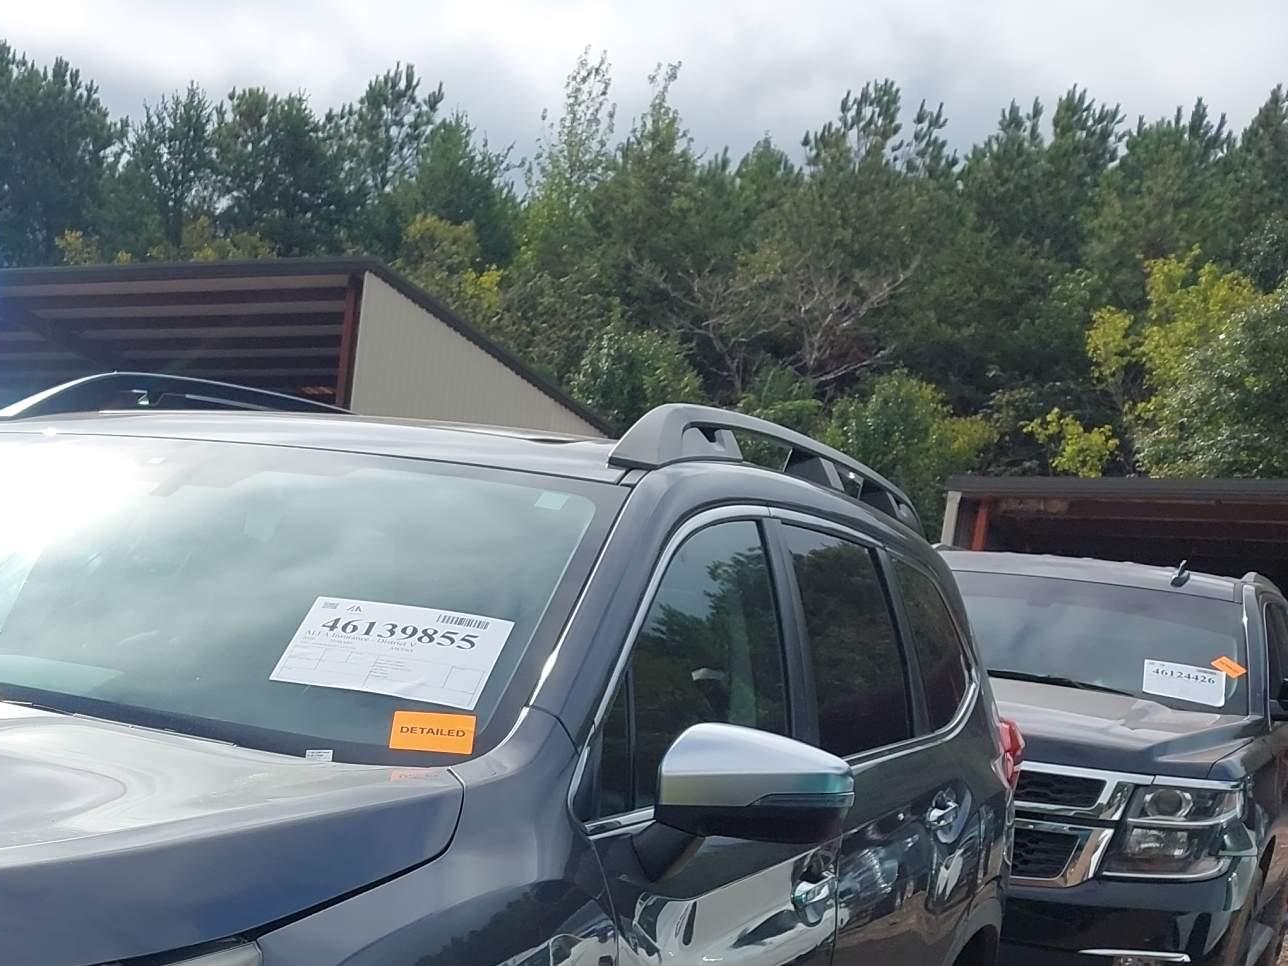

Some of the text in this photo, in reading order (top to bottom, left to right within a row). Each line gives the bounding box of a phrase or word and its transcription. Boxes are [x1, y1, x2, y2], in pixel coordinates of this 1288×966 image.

[320, 616, 480, 650] 46139855
[1152, 668, 1216, 685] 46124426
[399, 725, 466, 738] DETAILED
